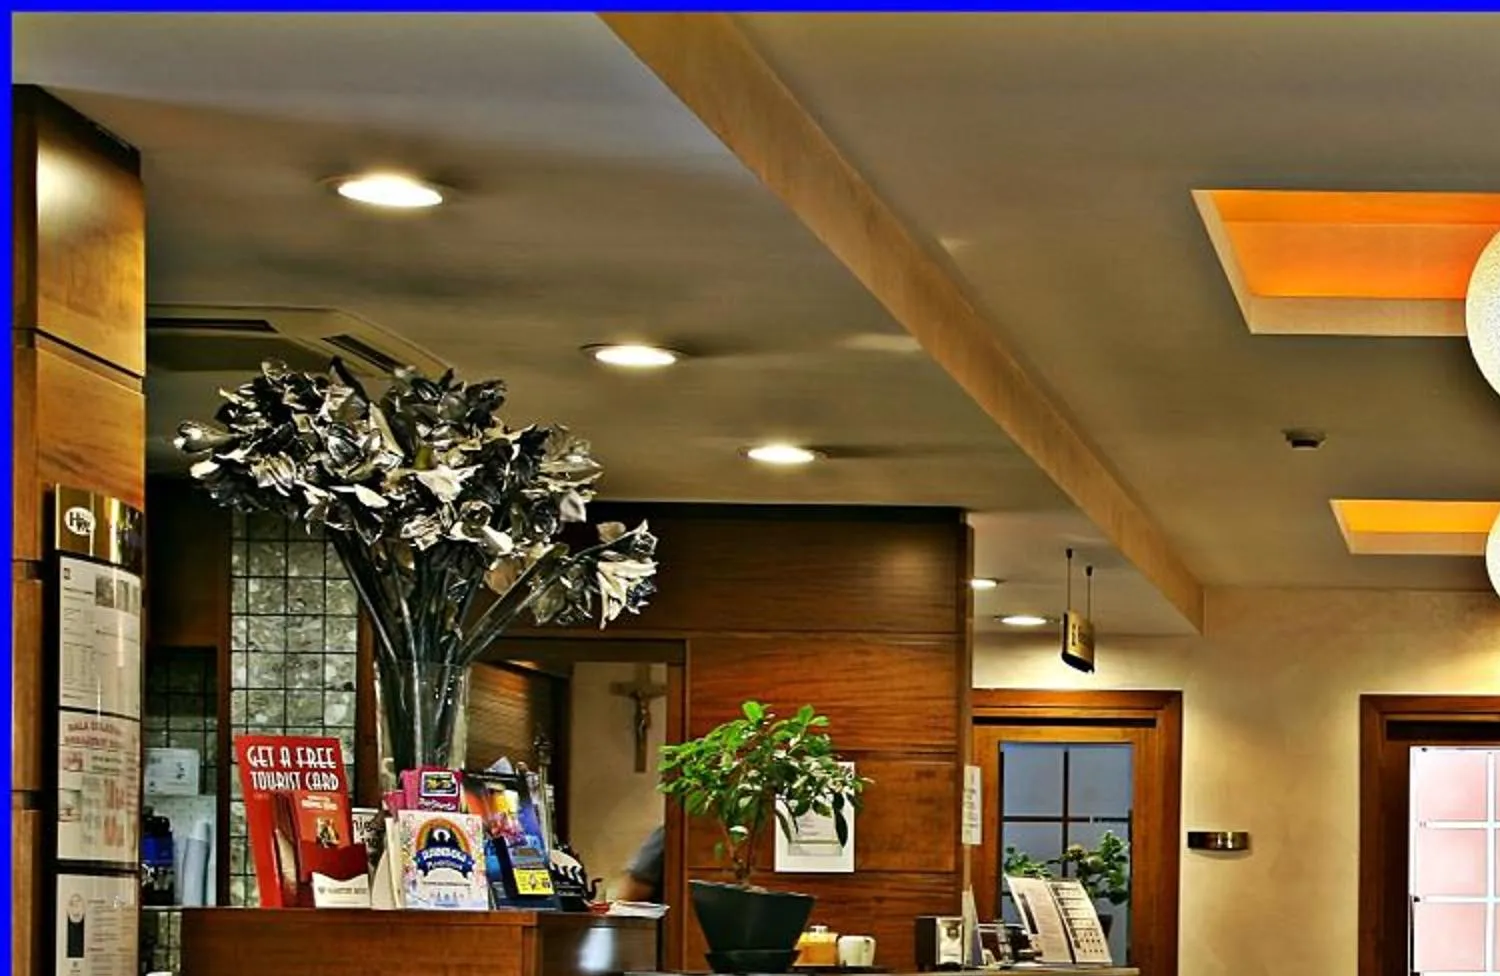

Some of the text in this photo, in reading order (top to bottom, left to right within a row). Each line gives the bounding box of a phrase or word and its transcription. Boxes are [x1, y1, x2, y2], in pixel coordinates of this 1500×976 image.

[247, 745, 337, 769] GET A FREE
[250, 771, 339, 790] TOURIST CARD
